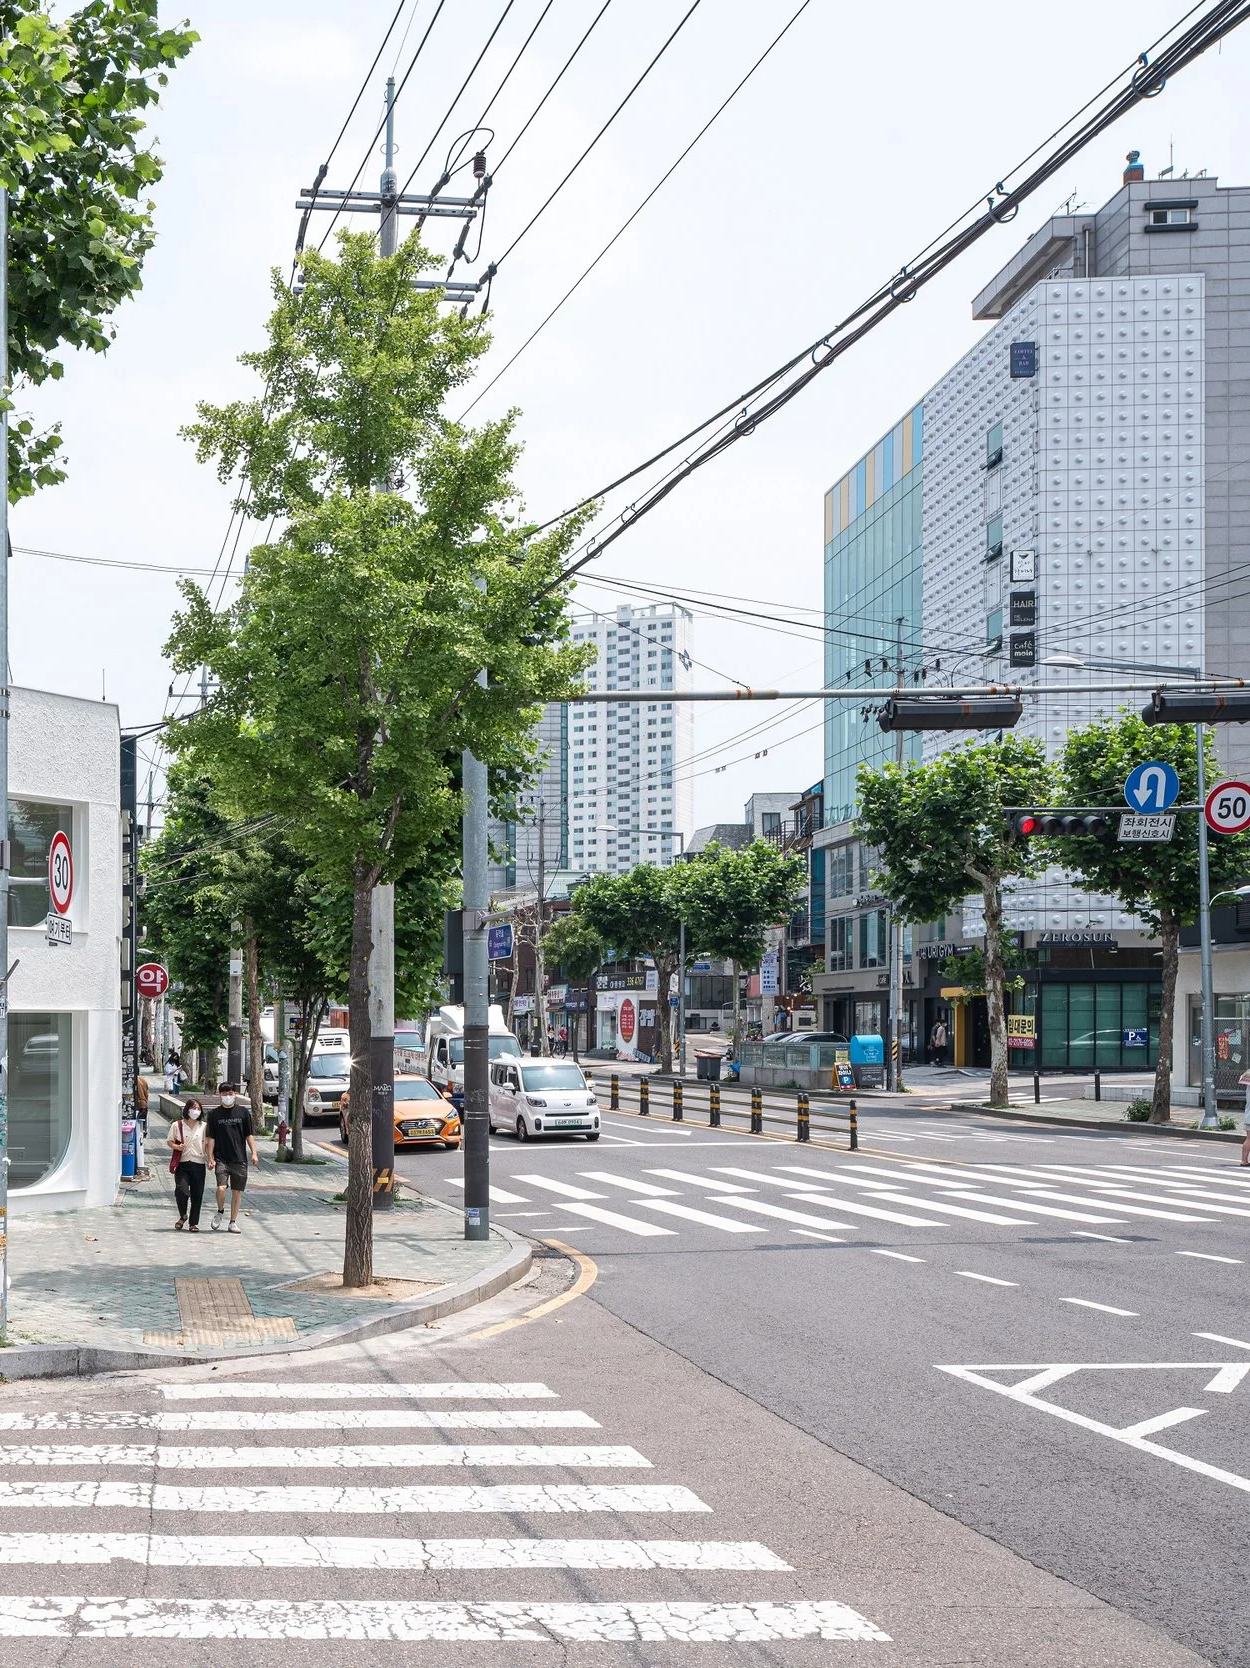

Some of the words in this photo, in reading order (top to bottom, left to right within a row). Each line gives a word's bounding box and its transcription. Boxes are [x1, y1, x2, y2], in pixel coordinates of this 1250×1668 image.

[1013, 600, 1034, 608] HAIR
[1217, 796, 1247, 820] 50
[1123, 817, 1172, 828] 좌회전시
[1121, 829, 1170, 839] 보행신호시
[54, 853, 69, 891] 30
[49, 919, 71, 941] 여기부터
[1041, 932, 1114, 942] ZEROSUN
[139, 969, 164, 993] 약
[1008, 1018, 1034, 1035] 임대문의
